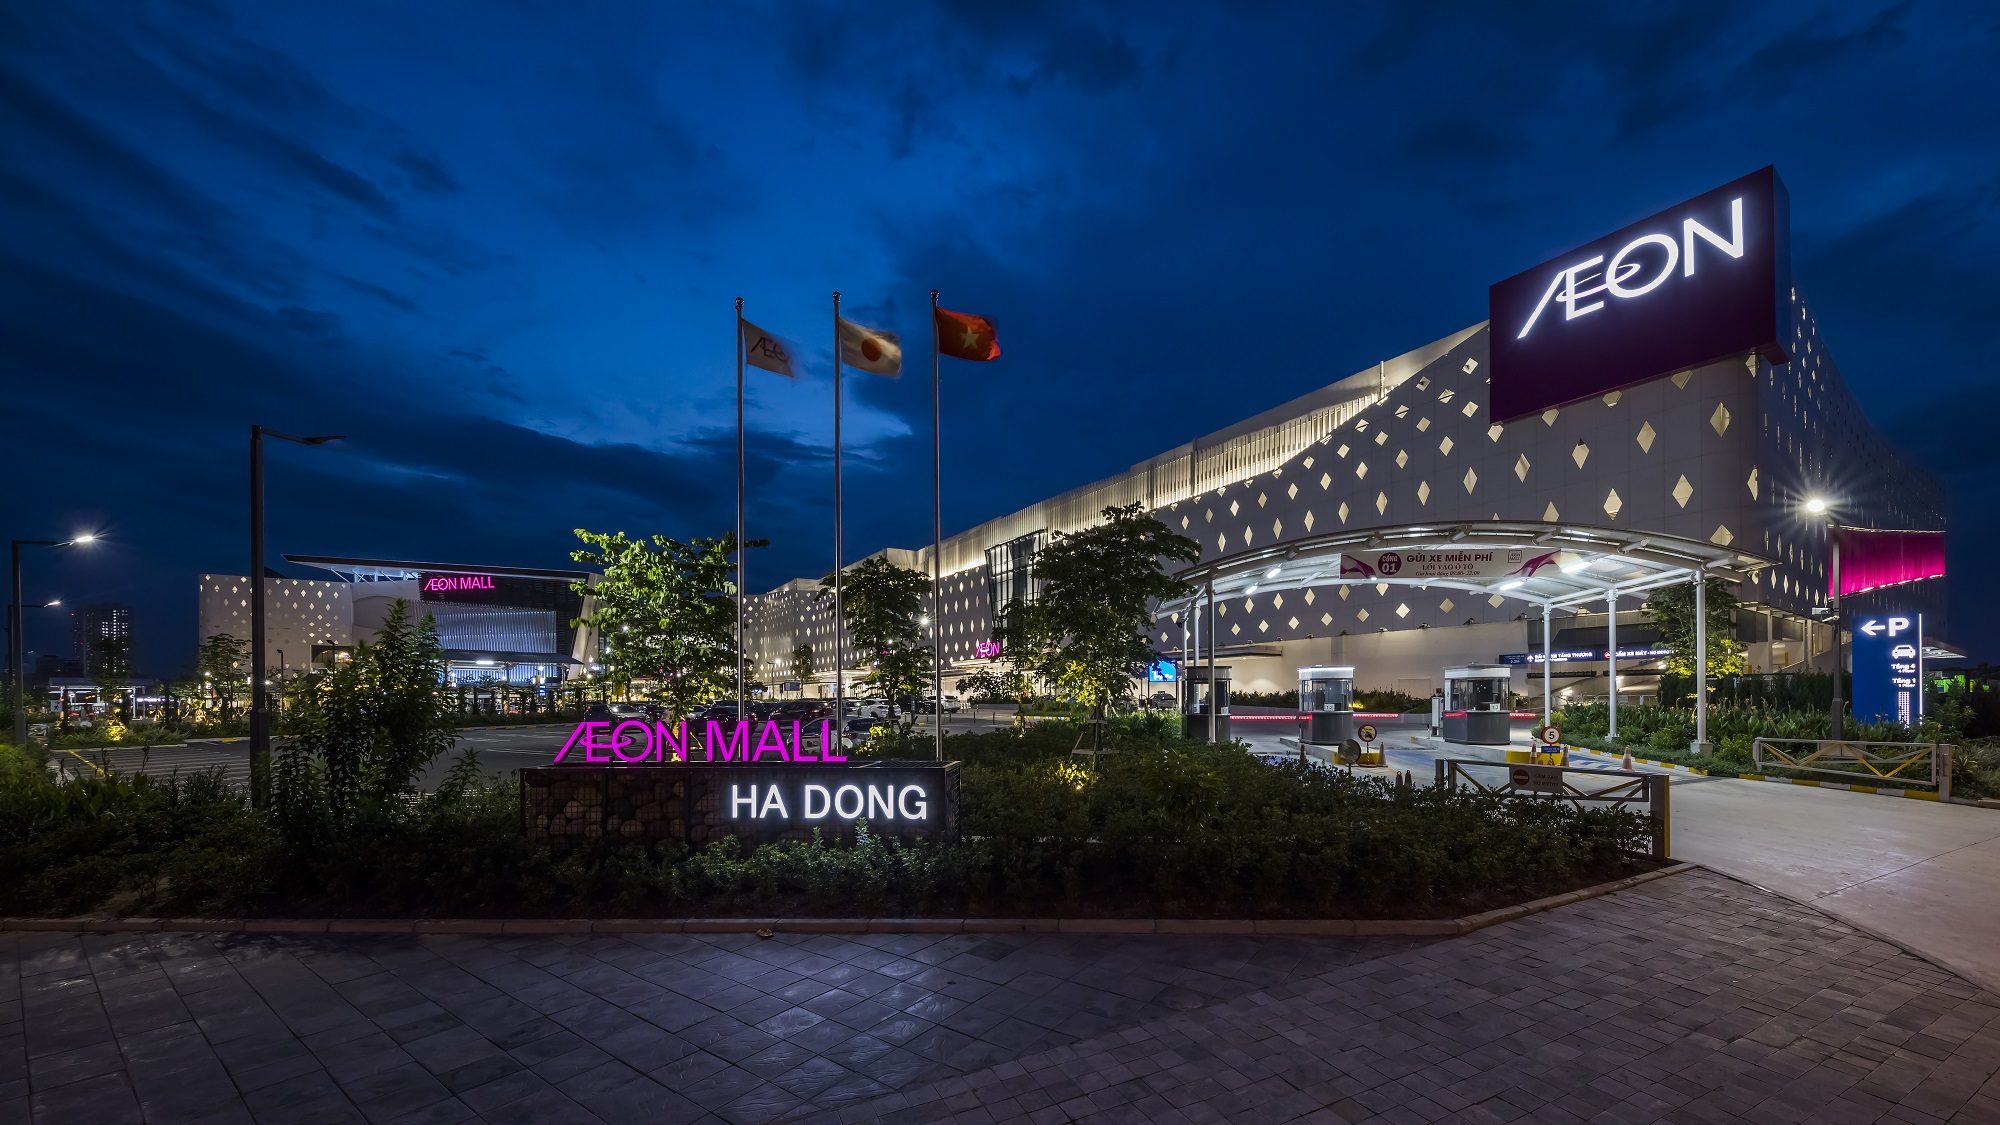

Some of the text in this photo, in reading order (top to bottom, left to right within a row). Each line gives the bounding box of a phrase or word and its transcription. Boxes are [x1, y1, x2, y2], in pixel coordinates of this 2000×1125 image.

[1445, 551, 1471, 562] MIỄN
[1475, 552, 1493, 561] PHÍ
[1382, 563, 1397, 573] 01
[460, 576, 495, 590] MALL
[1888, 617, 1909, 636] P
[707, 720, 847, 763] MALL
[1549, 731, 1555, 740] 5
[732, 784, 927, 820] HA DONG
